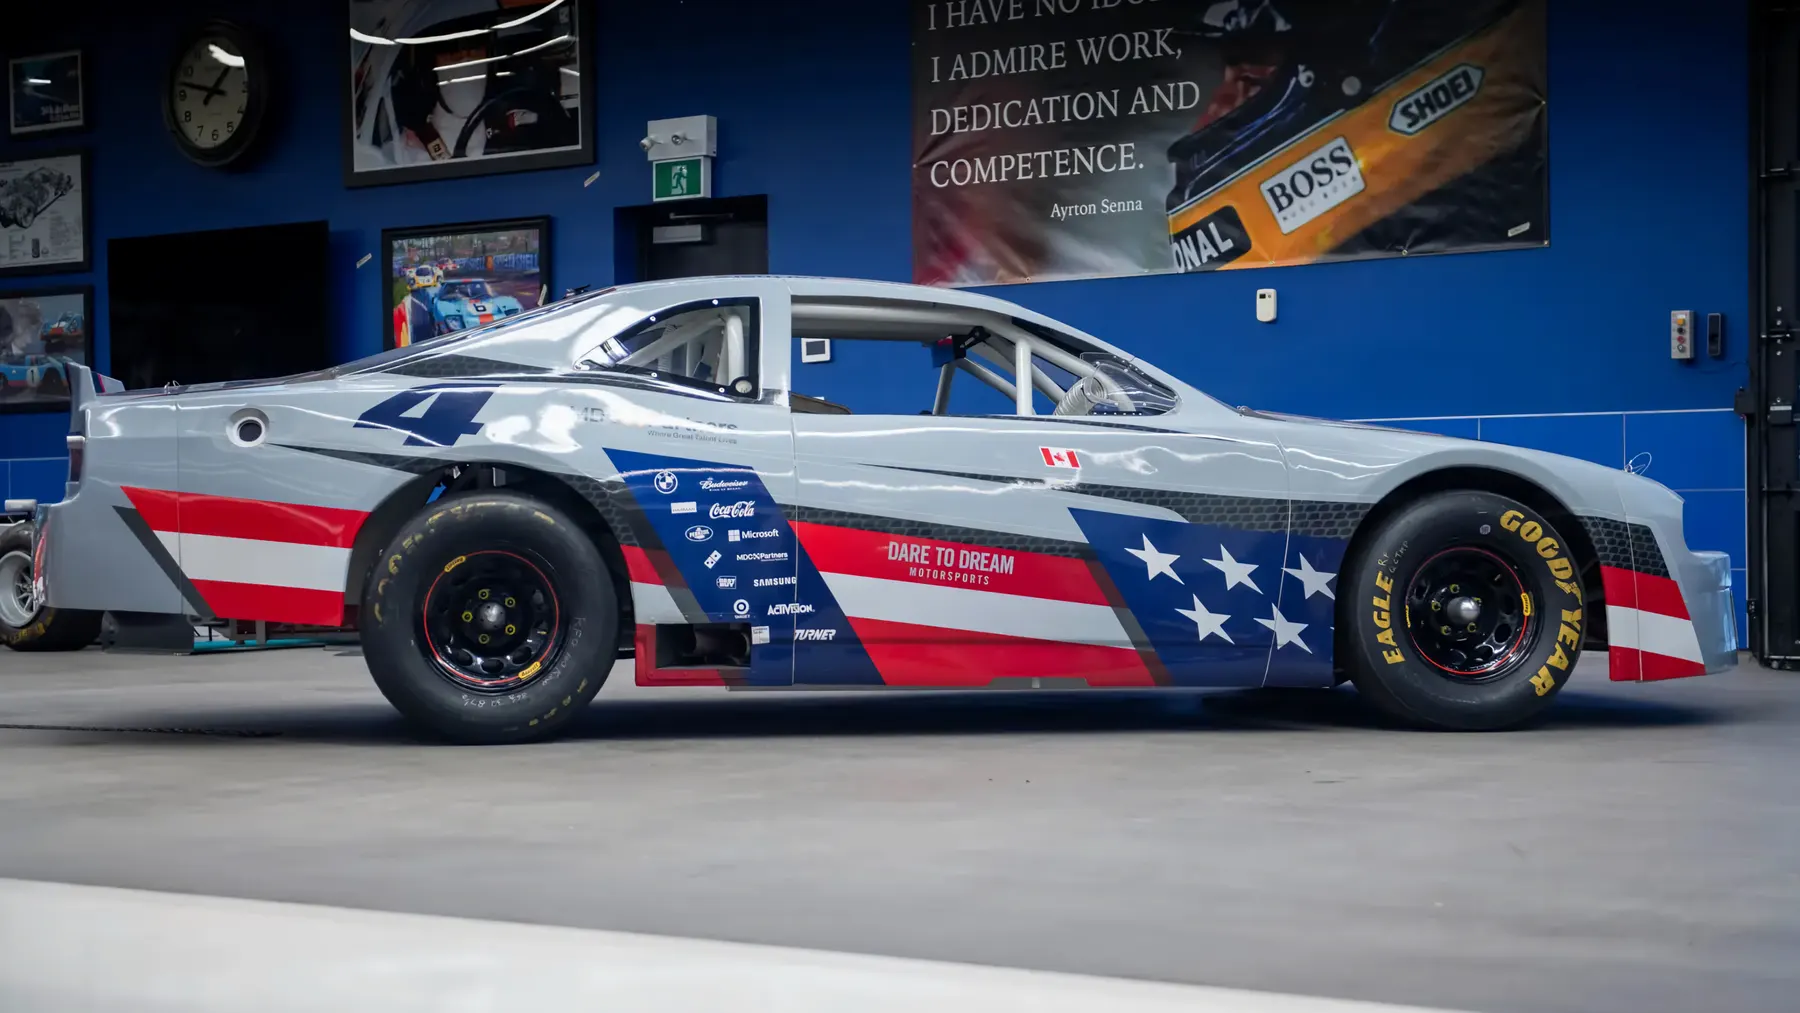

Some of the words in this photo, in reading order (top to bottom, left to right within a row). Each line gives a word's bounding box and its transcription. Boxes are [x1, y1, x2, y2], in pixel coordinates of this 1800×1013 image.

[928, 3, 937, 31] I
[946, 0, 1025, 28] HAVE
[931, 56, 941, 83] I
[949, 41, 1068, 81] ADMIRE
[1076, 27, 1182, 66] WORK,
[179, 90, 187, 102] 9
[1400, 69, 1475, 129] SHOEI
[184, 110, 192, 122] 8
[930, 89, 1119, 136] DEDICATION
[1128, 81, 1200, 119] AND
[197, 125, 204, 137] 7
[211, 129, 219, 141] 6
[226, 121, 234, 134] 5
[930, 142, 1144, 188] COMPETENCE.
[1266, 145, 1354, 213] BOSS
[1050, 203, 1097, 219] Ayrton
[1101, 197, 1143, 214] Senna
[1171, 221, 1234, 274] ONAL
[353, 383, 507, 448] 4
[699, 480, 749, 490] Budweiser
[709, 500, 755, 519] Coca-Cola
[741, 529, 780, 539] Microsoft
[888, 541, 931, 565] DARE
[935, 547, 955, 568] TO
[958, 550, 1015, 575] DREAM
[753, 576, 797, 587] SAMSUNG
[909, 567, 990, 586] MOTORSPORTS
[1372, 571, 1406, 665] EAGLE
[794, 629, 837, 641] TURNER
